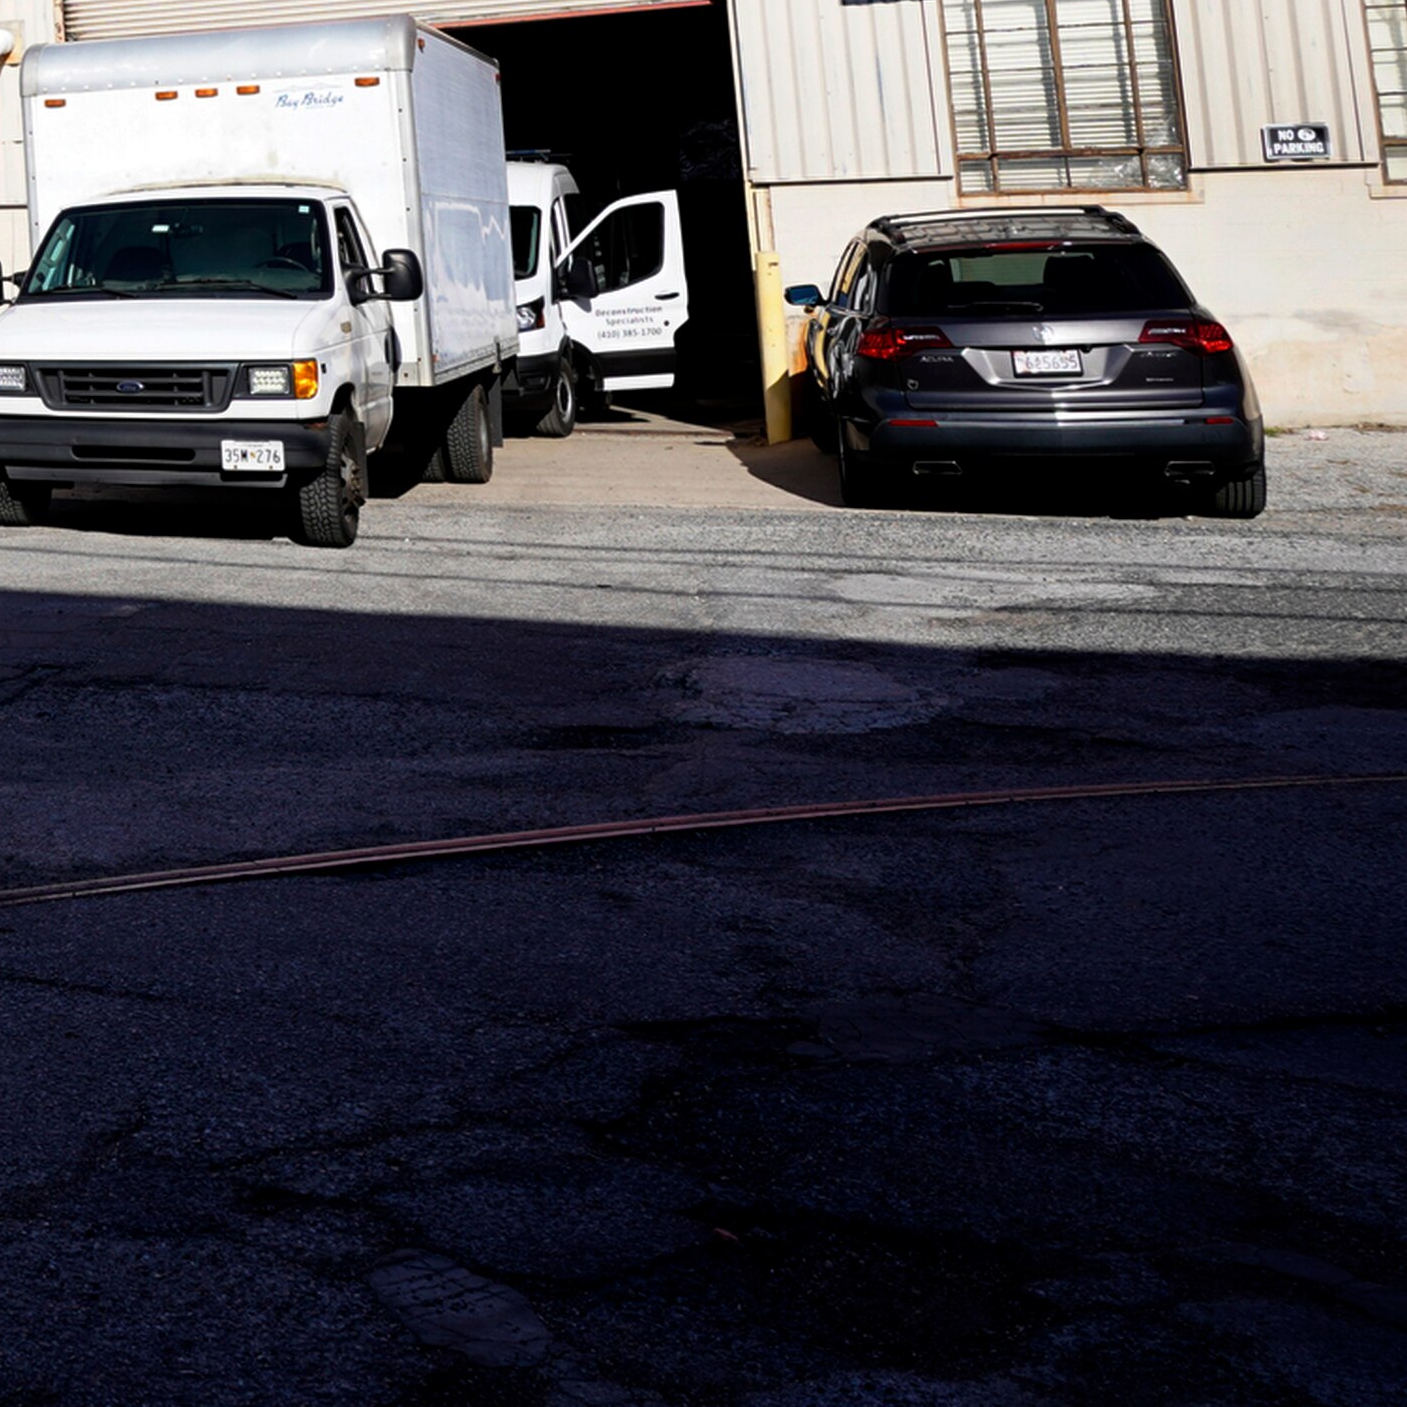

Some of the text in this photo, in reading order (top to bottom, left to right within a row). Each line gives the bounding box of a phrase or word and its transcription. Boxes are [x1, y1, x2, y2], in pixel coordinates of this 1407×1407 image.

[274, 92, 344, 110] Bay Bridge
[1277, 129, 1295, 141] NO
[1273, 142, 1325, 154] PARKING
[595, 306, 663, 317] Deconstruction
[606, 316, 654, 326] Specialists
